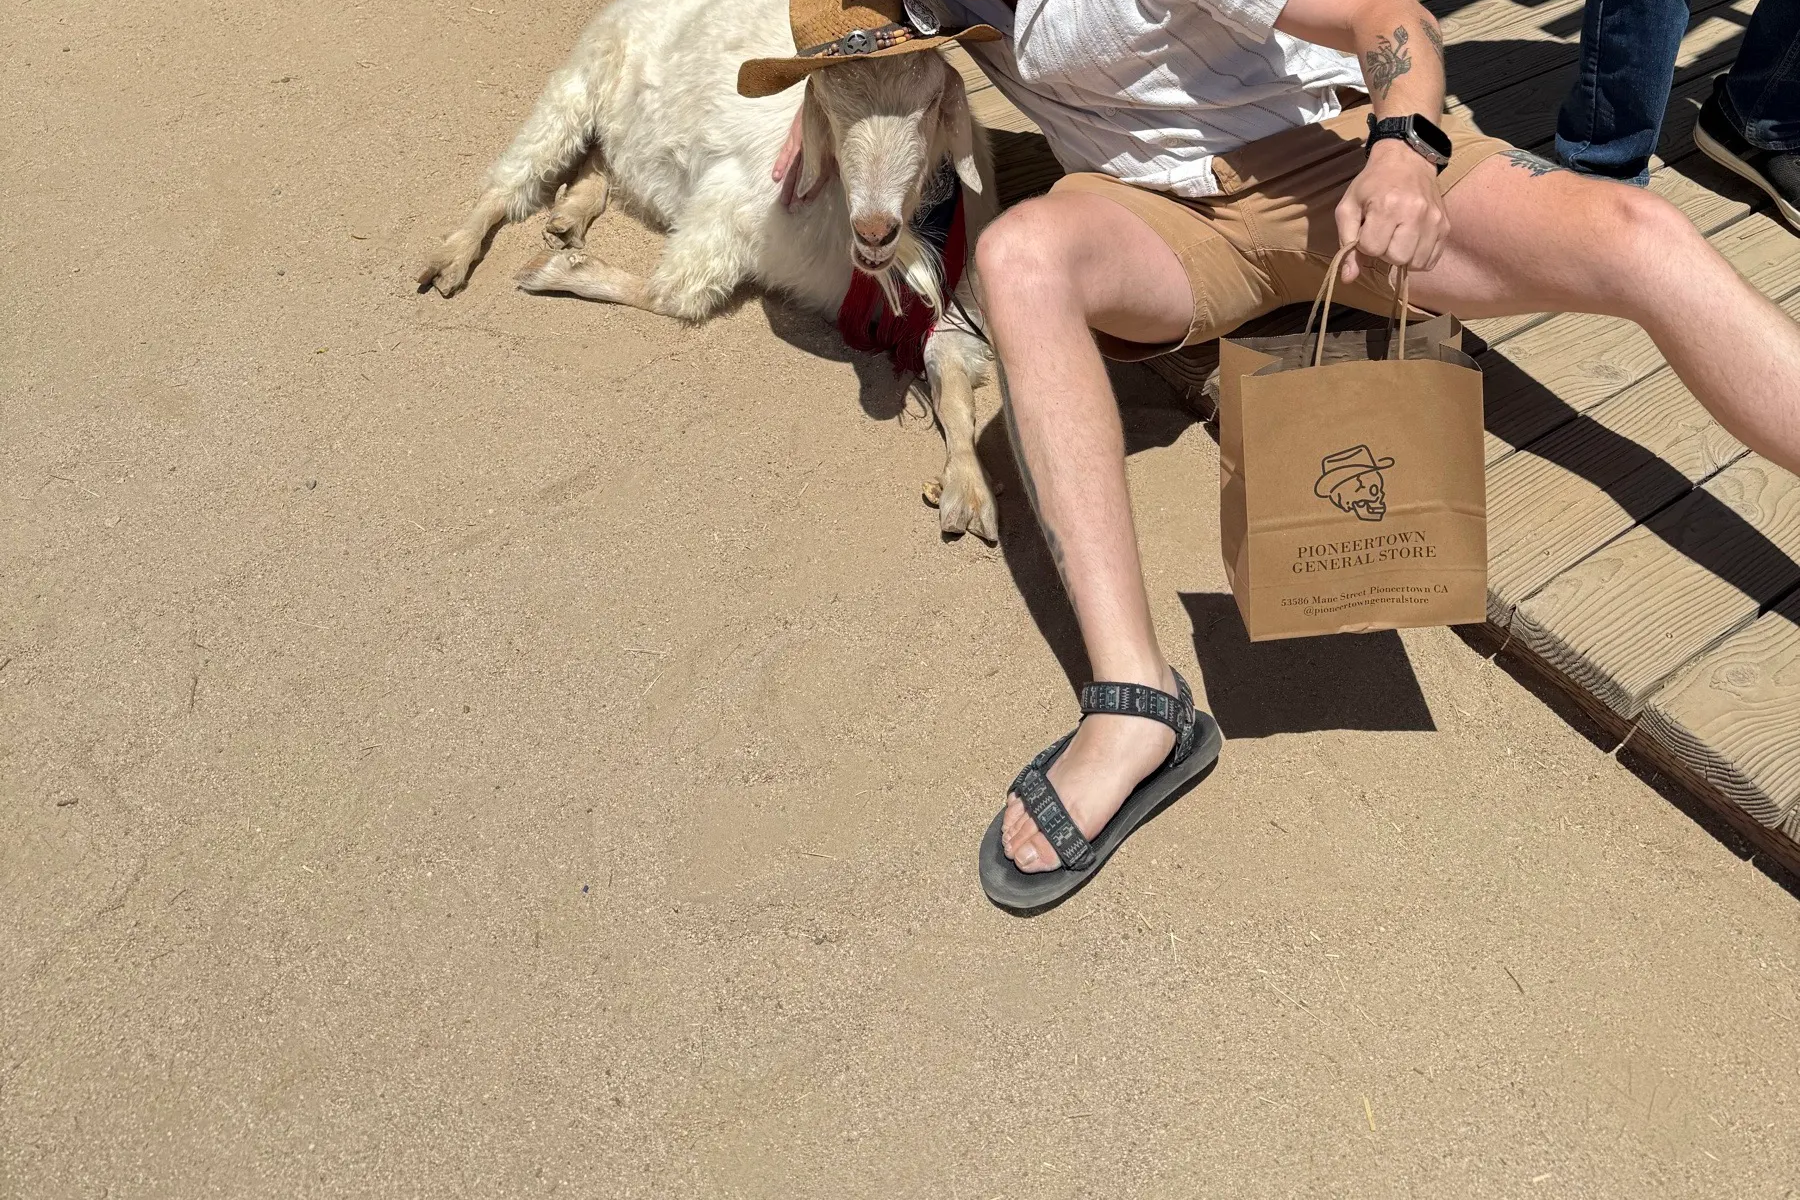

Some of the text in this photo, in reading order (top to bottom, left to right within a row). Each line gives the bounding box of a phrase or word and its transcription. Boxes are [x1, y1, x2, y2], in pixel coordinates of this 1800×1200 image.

[1297, 530, 1426, 559] PIONEERTOWN
[1292, 545, 1437, 574] GENERAL STORE
[1281, 584, 1449, 607] 53586 Mane Street Pioneertown CA
